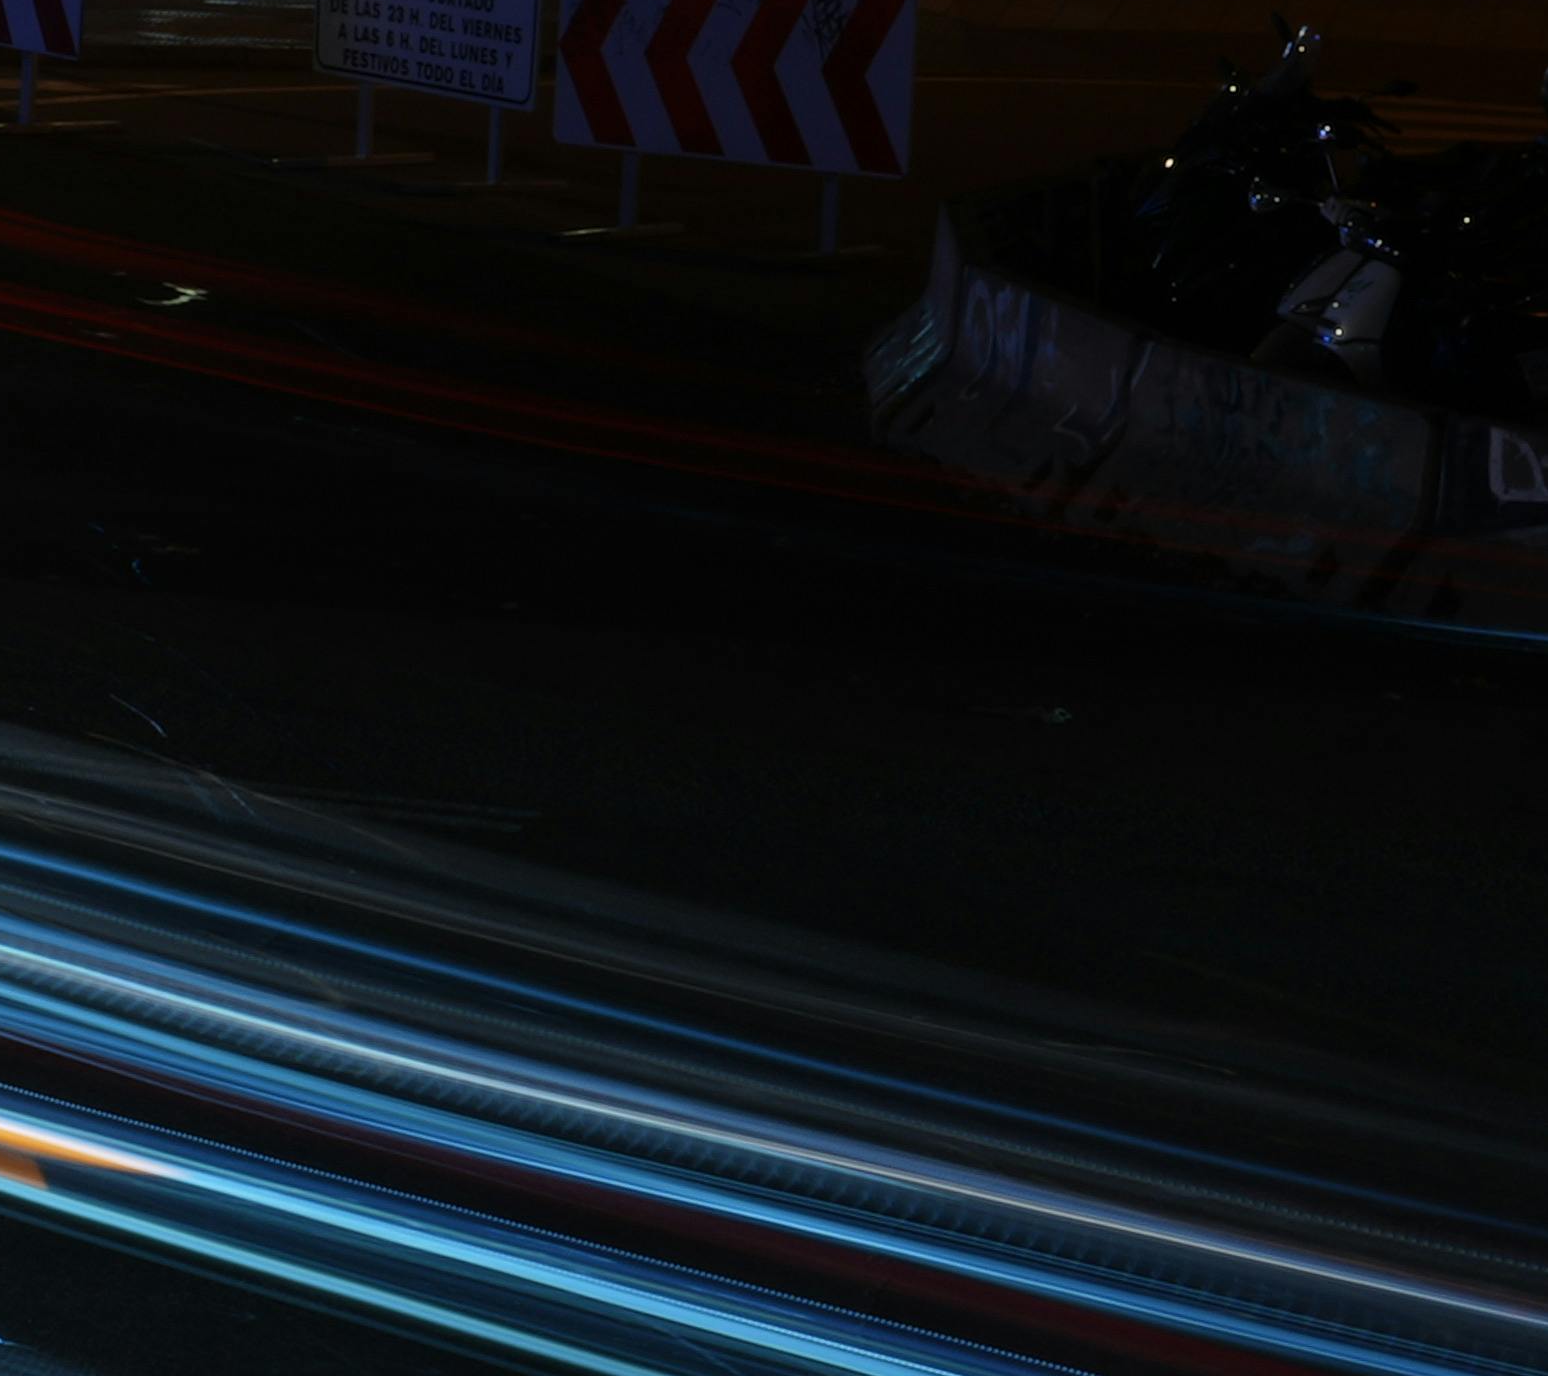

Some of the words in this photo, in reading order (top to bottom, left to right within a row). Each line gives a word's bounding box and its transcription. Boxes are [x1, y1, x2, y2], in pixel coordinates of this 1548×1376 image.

[354, 0, 381, 19] LAS
[387, 4, 405, 24] 23
[430, 10, 455, 33] DEL
[462, 17, 523, 45] VIERNES
[337, 23, 347, 41] A
[354, 25, 380, 45] LAS
[386, 29, 395, 48] 6
[419, 35, 446, 57] DEL
[450, 40, 498, 66] LUNES
[505, 51, 515, 69] Y
[343, 47, 409, 76] FESTIVOS
[415, 61, 455, 84] TODO
[460, 69, 477, 90] EL
